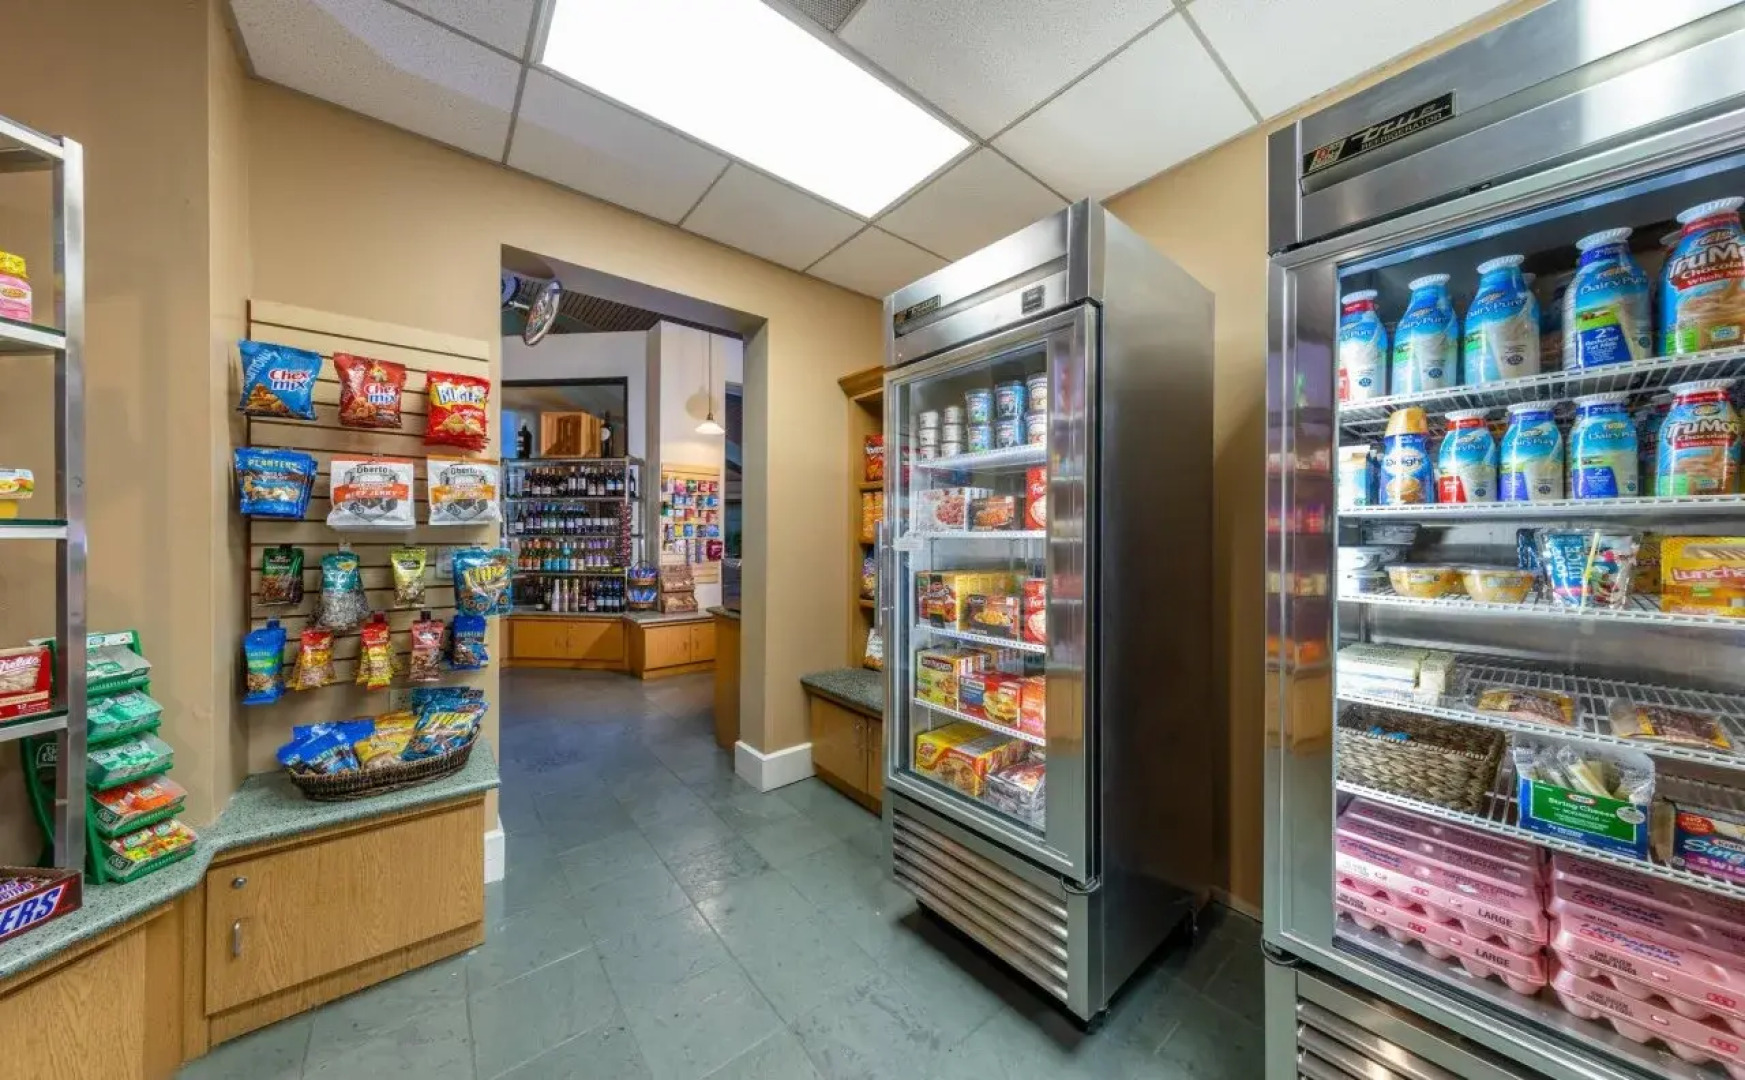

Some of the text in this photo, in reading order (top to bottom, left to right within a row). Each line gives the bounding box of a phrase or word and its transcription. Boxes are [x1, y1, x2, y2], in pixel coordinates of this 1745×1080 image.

[1548, 797, 1578, 811] String
[1579, 805, 1617, 818] Cheese
[1477, 907, 1513, 927] LARGE
[1475, 948, 1511, 968] LARGE
